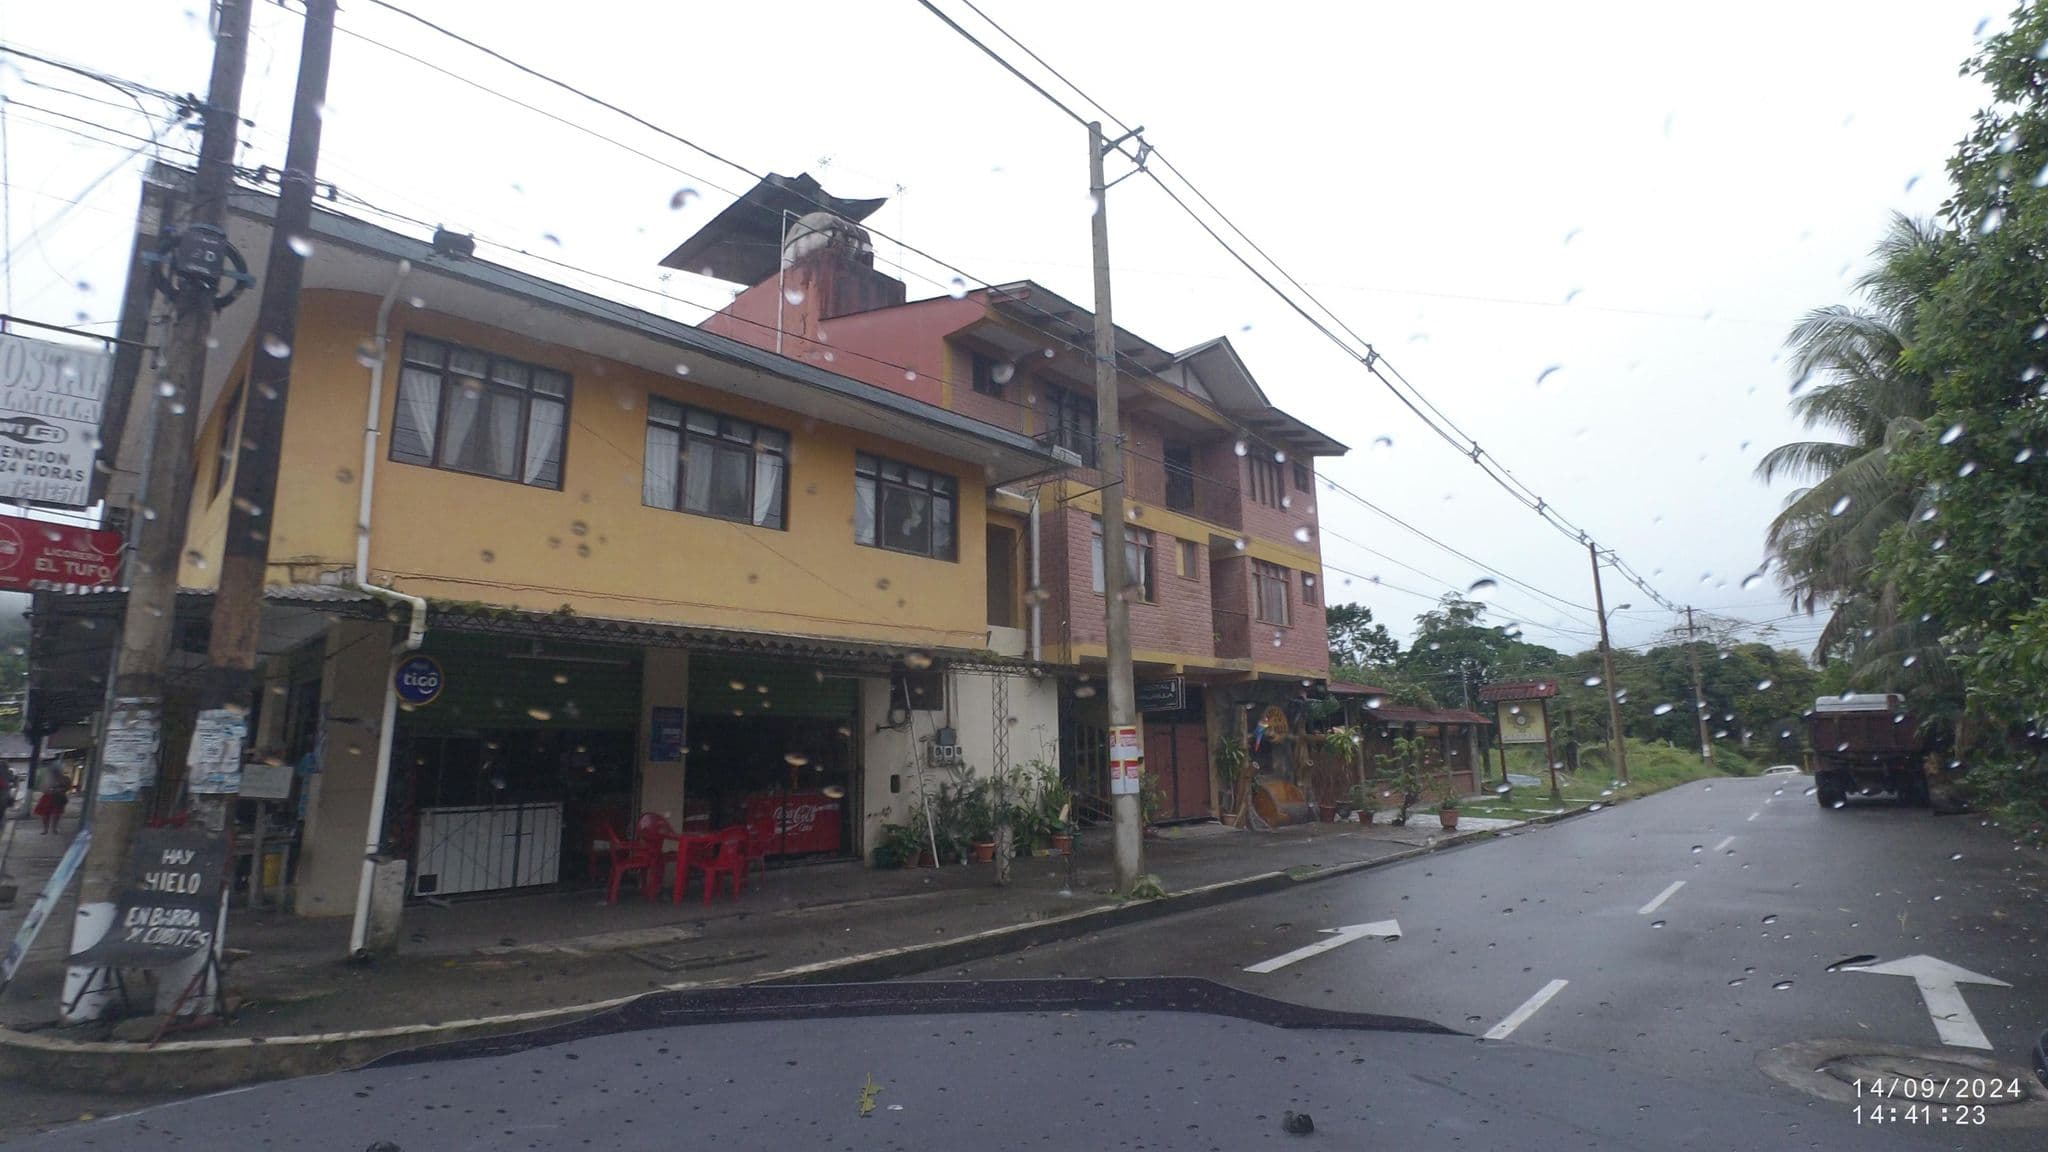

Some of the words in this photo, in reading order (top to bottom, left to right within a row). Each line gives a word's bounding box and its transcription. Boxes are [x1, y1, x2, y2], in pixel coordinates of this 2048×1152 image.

[0, 444, 71, 466] ENCION
[24, 463, 85, 482] HORAS
[35, 557, 60, 574] EL
[63, 560, 112, 580] TUFO
[403, 672, 438, 694] tigo
[161, 848, 197, 865] HAY
